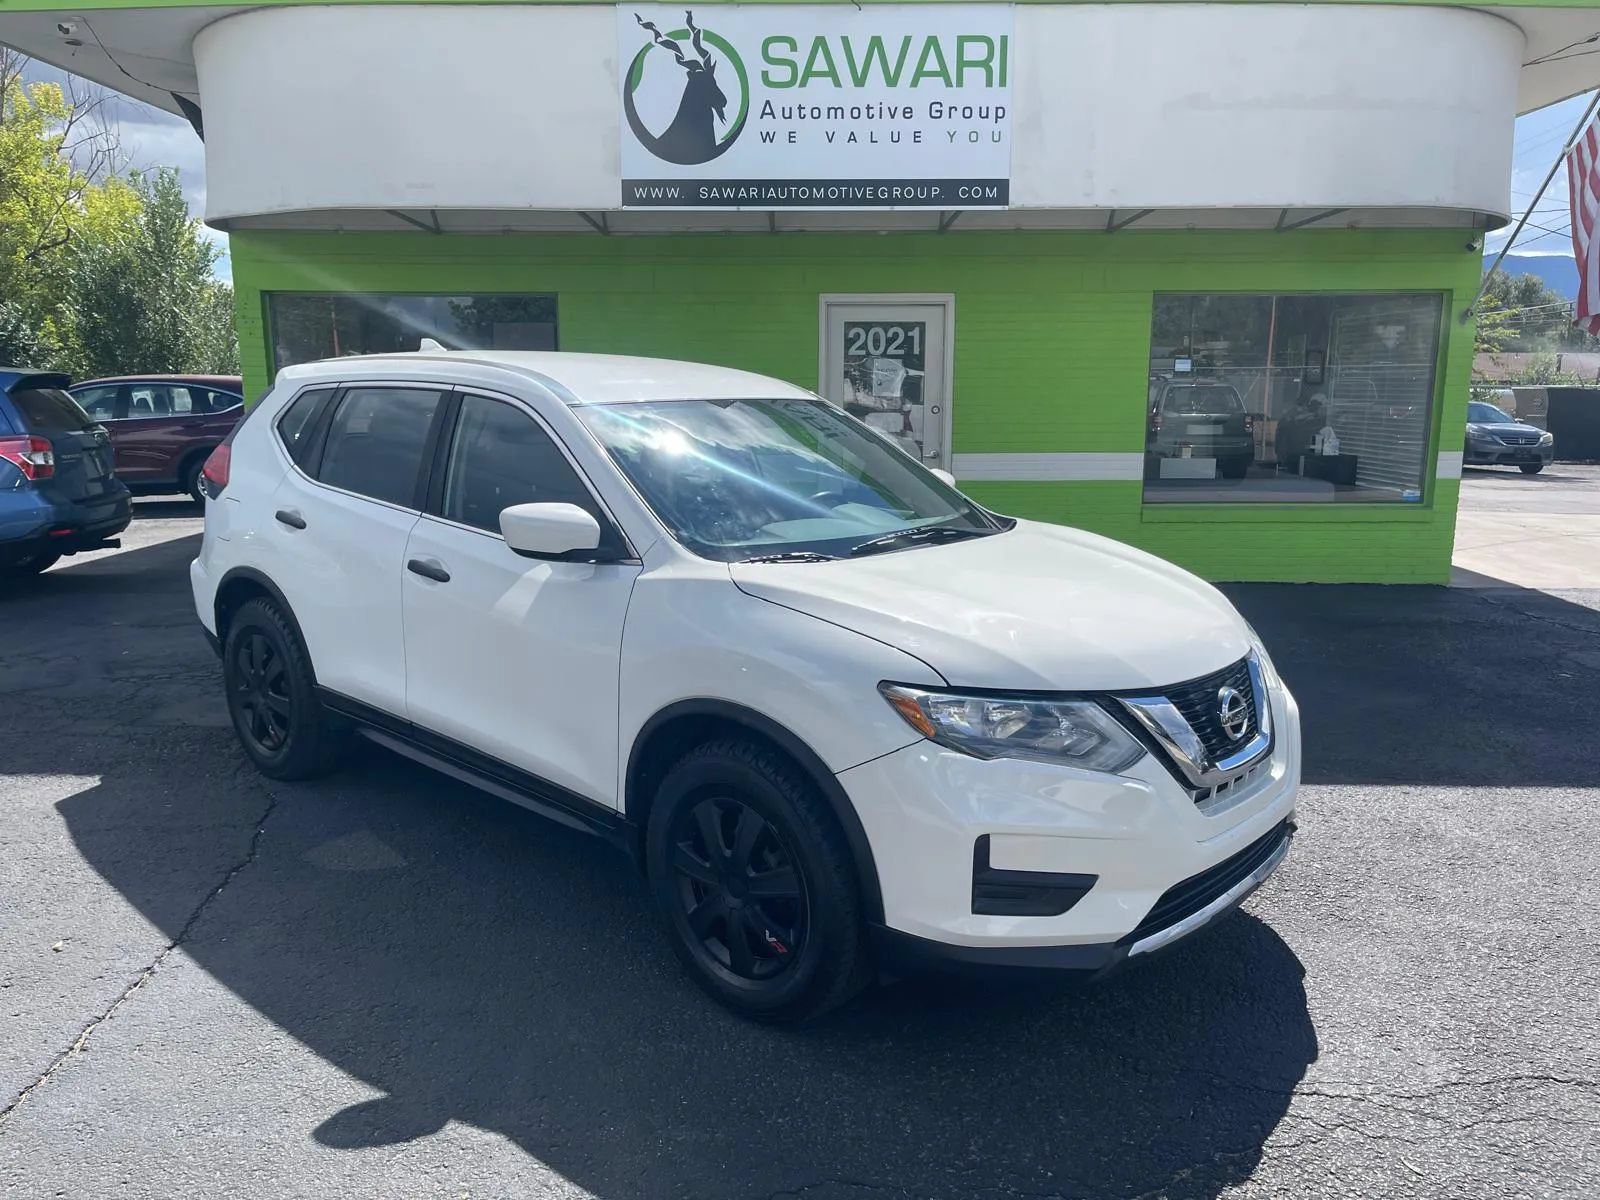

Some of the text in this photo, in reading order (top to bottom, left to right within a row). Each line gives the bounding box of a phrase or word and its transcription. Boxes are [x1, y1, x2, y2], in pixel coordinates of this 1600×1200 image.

[760, 34, 1009, 89] SAWARI
[759, 100, 1006, 124] Automotive Group
[760, 130, 1002, 143] WE VALUE YOU
[958, 186, 998, 199] COM
[847, 326, 920, 356] 2021
